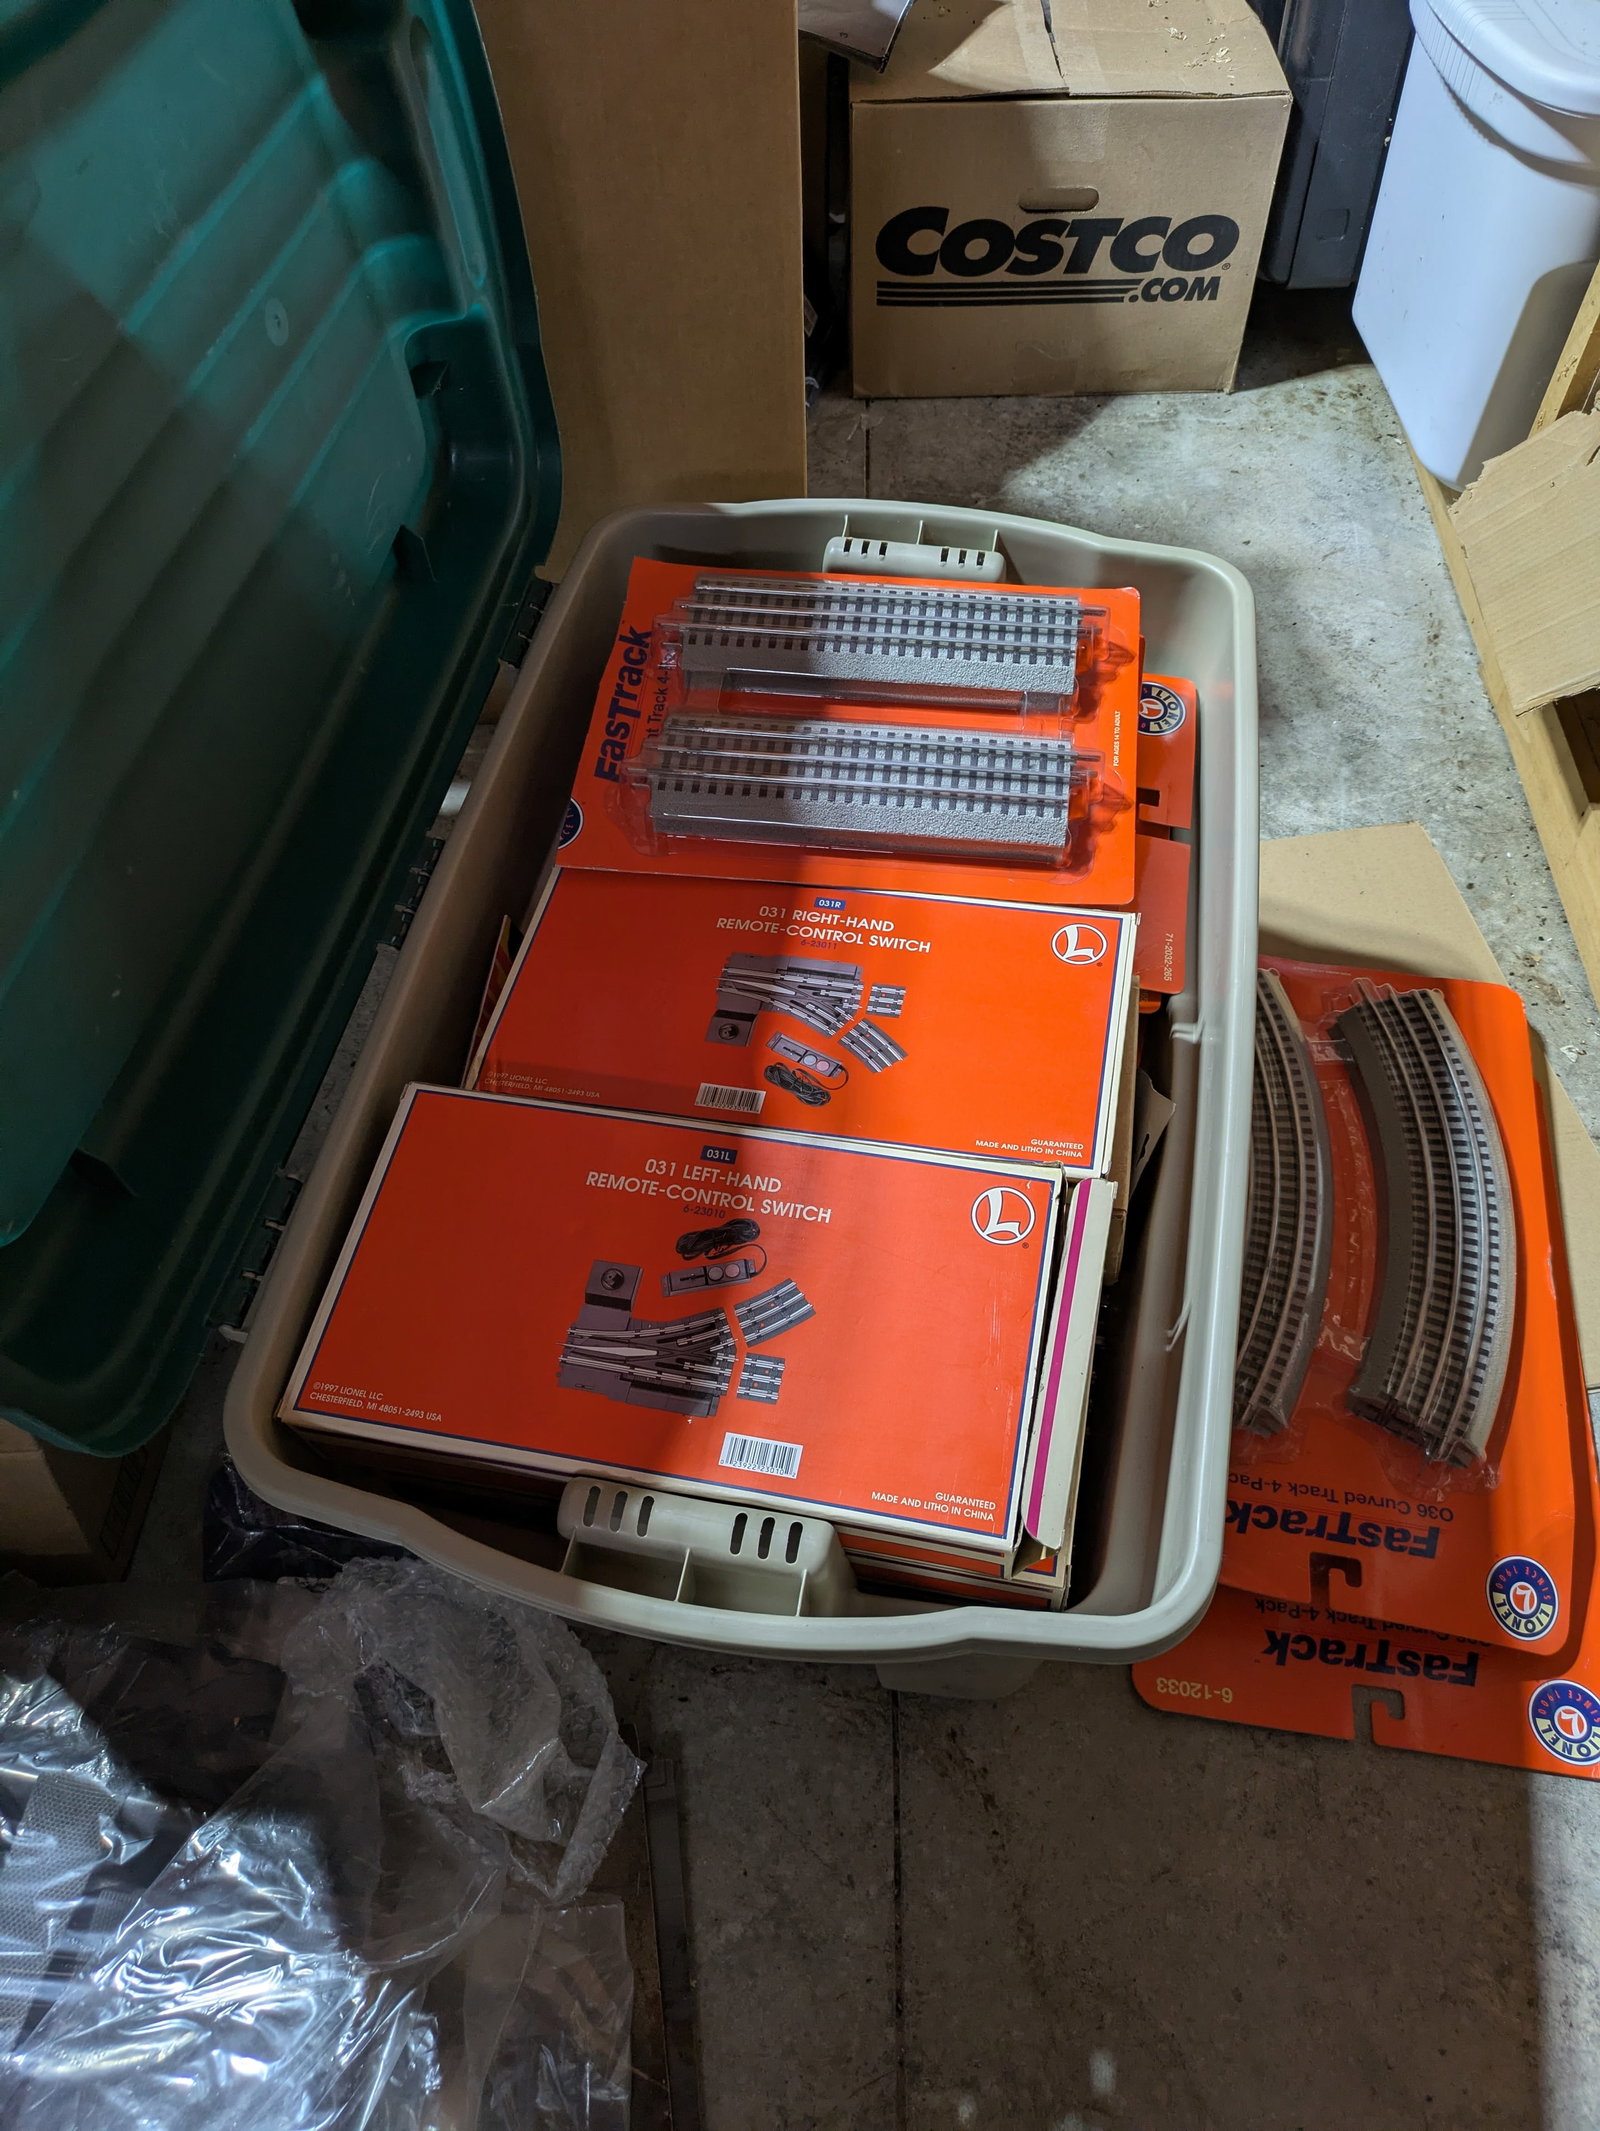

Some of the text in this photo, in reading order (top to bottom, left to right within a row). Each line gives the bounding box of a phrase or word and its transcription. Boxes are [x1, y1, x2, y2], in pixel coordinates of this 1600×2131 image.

[875, 206, 1240, 277] COSTCO
[1129, 276, 1222, 304] .COM
[594, 626, 652, 783] FasTrack
[647, 687, 669, 724] Track
[1154, 689, 1179, 730] LIONEL
[818, 899, 841, 909] 031R
[759, 905, 895, 932] 031 RIGHT-HAND
[716, 918, 932, 953] REMOTE-CONTROL SWITCH
[585, 1090, 600, 1098] USA
[706, 1149, 730, 1161] 031L
[975, 1140, 999, 1149] MADE
[1001, 1143, 1019, 1151] AND
[1021, 1146, 1043, 1154] LITHO
[1055, 1149, 1083, 1158] CHINA
[1031, 1139, 1084, 1150] GUARANTEED
[645, 1159, 782, 1193] 031 LEFT-HAND
[586, 1171, 832, 1224] REMOTE-CONTROL SWITCH
[683, 1204, 726, 1219] 6-23010
[340, 1386, 367, 1398] LIONEL
[369, 1391, 384, 1401] LLC
[367, 1402, 377, 1411] MI
[378, 1403, 424, 1419] 48051-2493
[426, 1412, 442, 1422] USA
[1229, 1473, 1281, 1493] 4-Pac
[1288, 1481, 1339, 1503] Track
[871, 1491, 994, 1521] MADE AND LITHO IN CHINA
[935, 1492, 996, 1510] GUARANTEED
[1344, 1491, 1411, 1515] Curved
[1226, 1500, 1440, 1559] FasTrack
[1496, 1598, 1549, 1633] LIONEL
[1262, 1629, 1479, 1687] FasTrack
[1156, 1677, 1233, 1703] 6-12033
